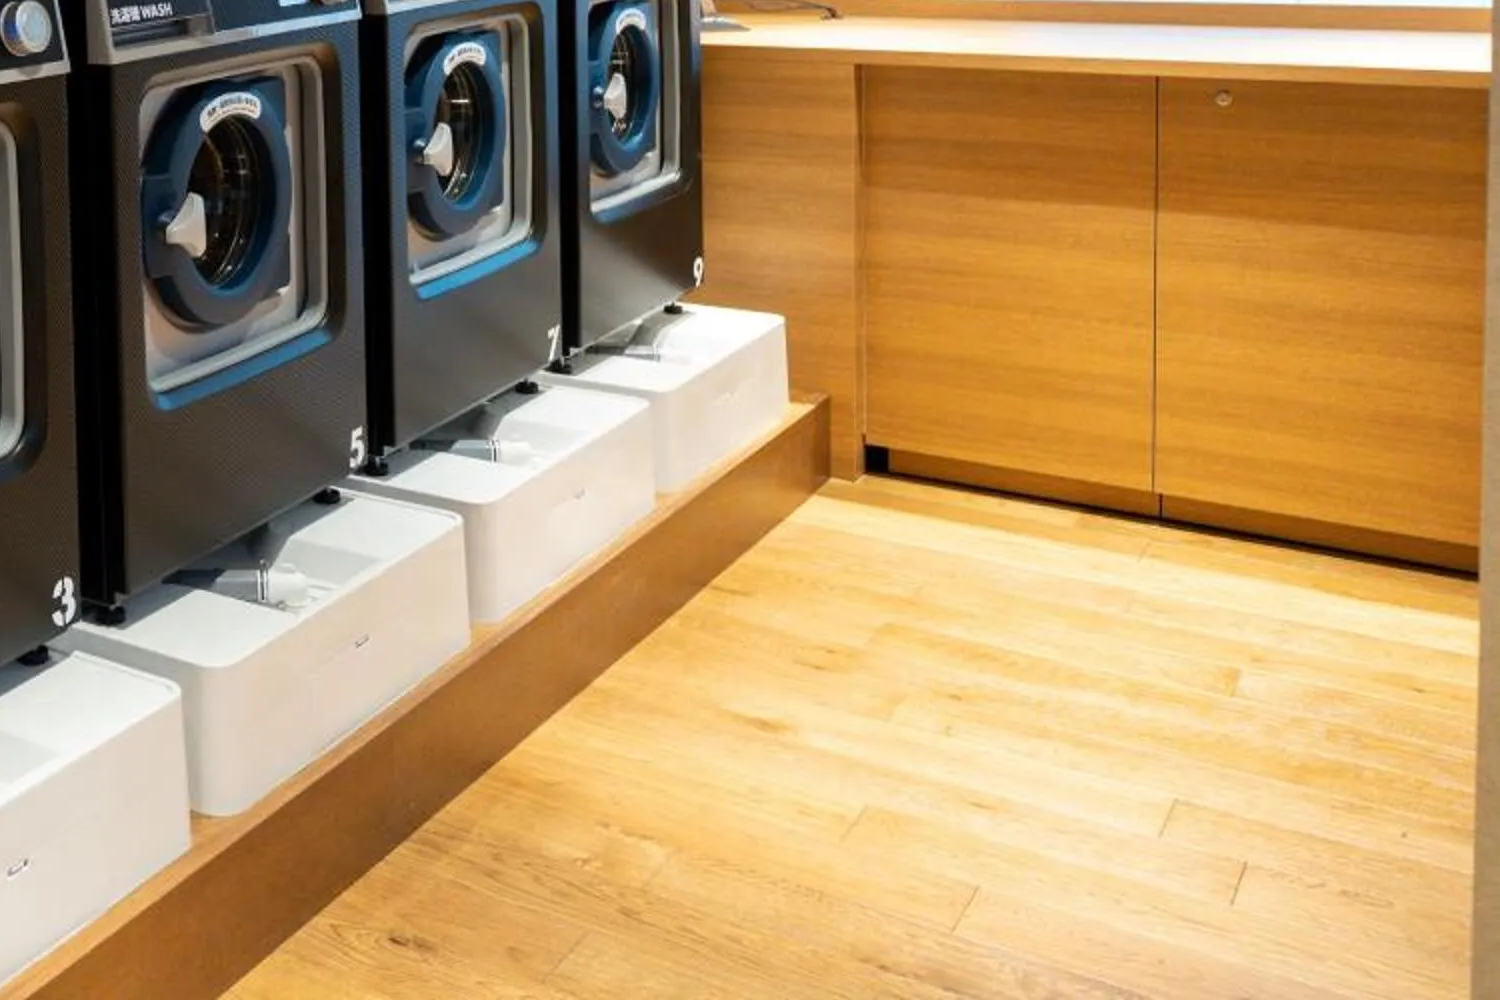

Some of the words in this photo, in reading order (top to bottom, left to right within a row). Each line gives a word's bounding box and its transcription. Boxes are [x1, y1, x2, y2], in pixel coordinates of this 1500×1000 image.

[140, 2, 173, 20] WASH
[693, 256, 703, 288] 9
[548, 323, 560, 361] 7
[350, 425, 365, 468] 5
[52, 576, 76, 626] 3
